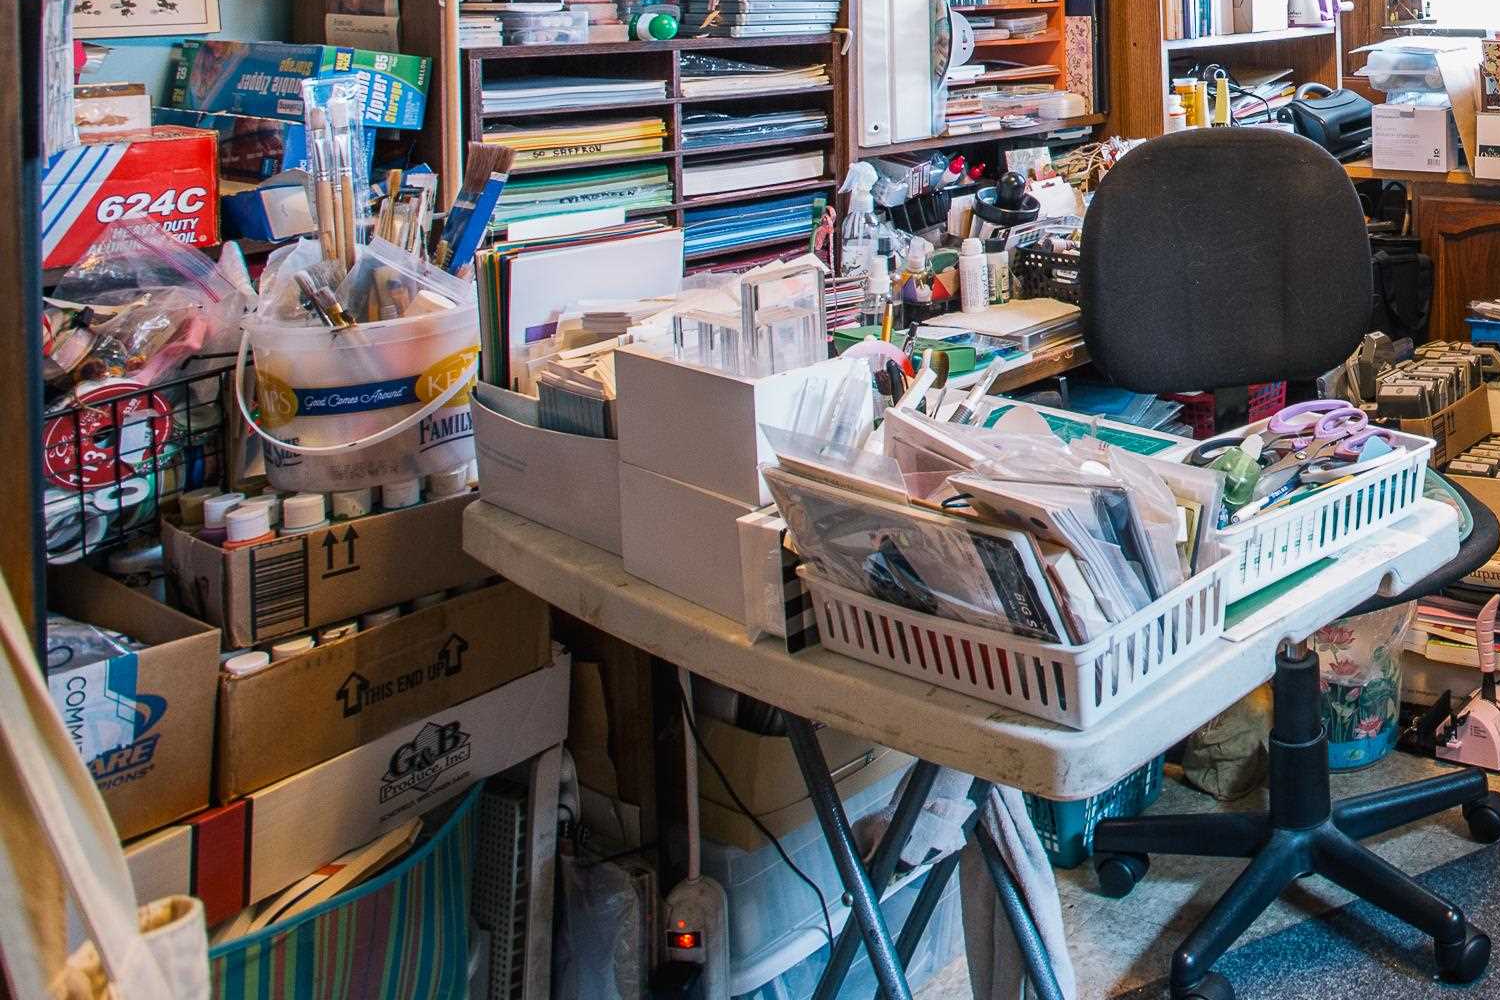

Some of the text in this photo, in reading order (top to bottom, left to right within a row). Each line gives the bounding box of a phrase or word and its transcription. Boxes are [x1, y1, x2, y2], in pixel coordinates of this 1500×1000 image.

[237, 71, 272, 95] Zipper
[417, 59, 428, 86] GALLON
[365, 73, 388, 122] Zipper
[97, 186, 208, 223] 624C
[163, 217, 199, 233] DUTY
[364, 662, 446, 705] THIS END UP
[389, 720, 462, 777] G&B
